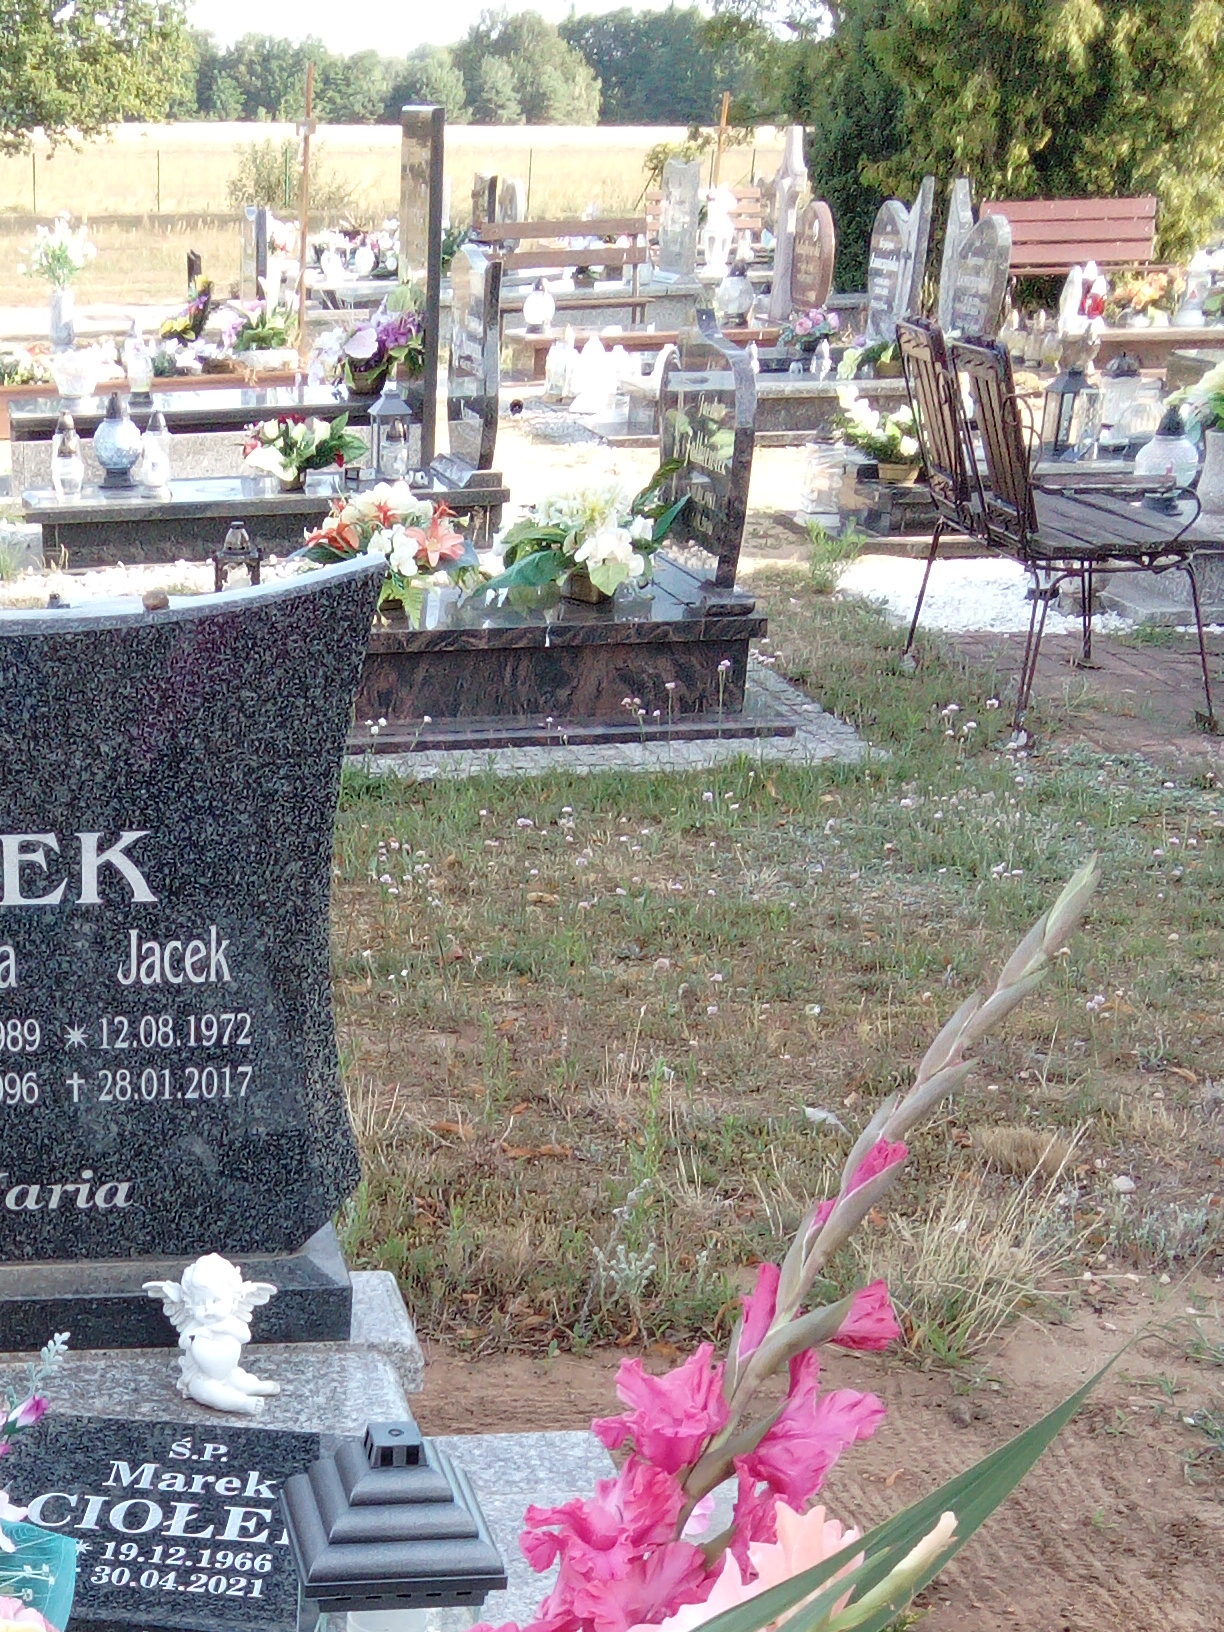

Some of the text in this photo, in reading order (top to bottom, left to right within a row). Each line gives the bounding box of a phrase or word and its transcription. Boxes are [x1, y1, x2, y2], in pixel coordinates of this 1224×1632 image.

[116, 925, 233, 986] Jacek
[98, 1012, 253, 1050] 12.08.1972
[98, 1064, 253, 1102] 28.01.2017
[168, 1437, 230, 1463] Ś.P.
[102, 1460, 277, 1500] Marek
[27, 1493, 290, 1546] CIOŁE
[99, 1540, 273, 1574] 19.12.1966
[90, 1565, 265, 1598] 30.04.2021
